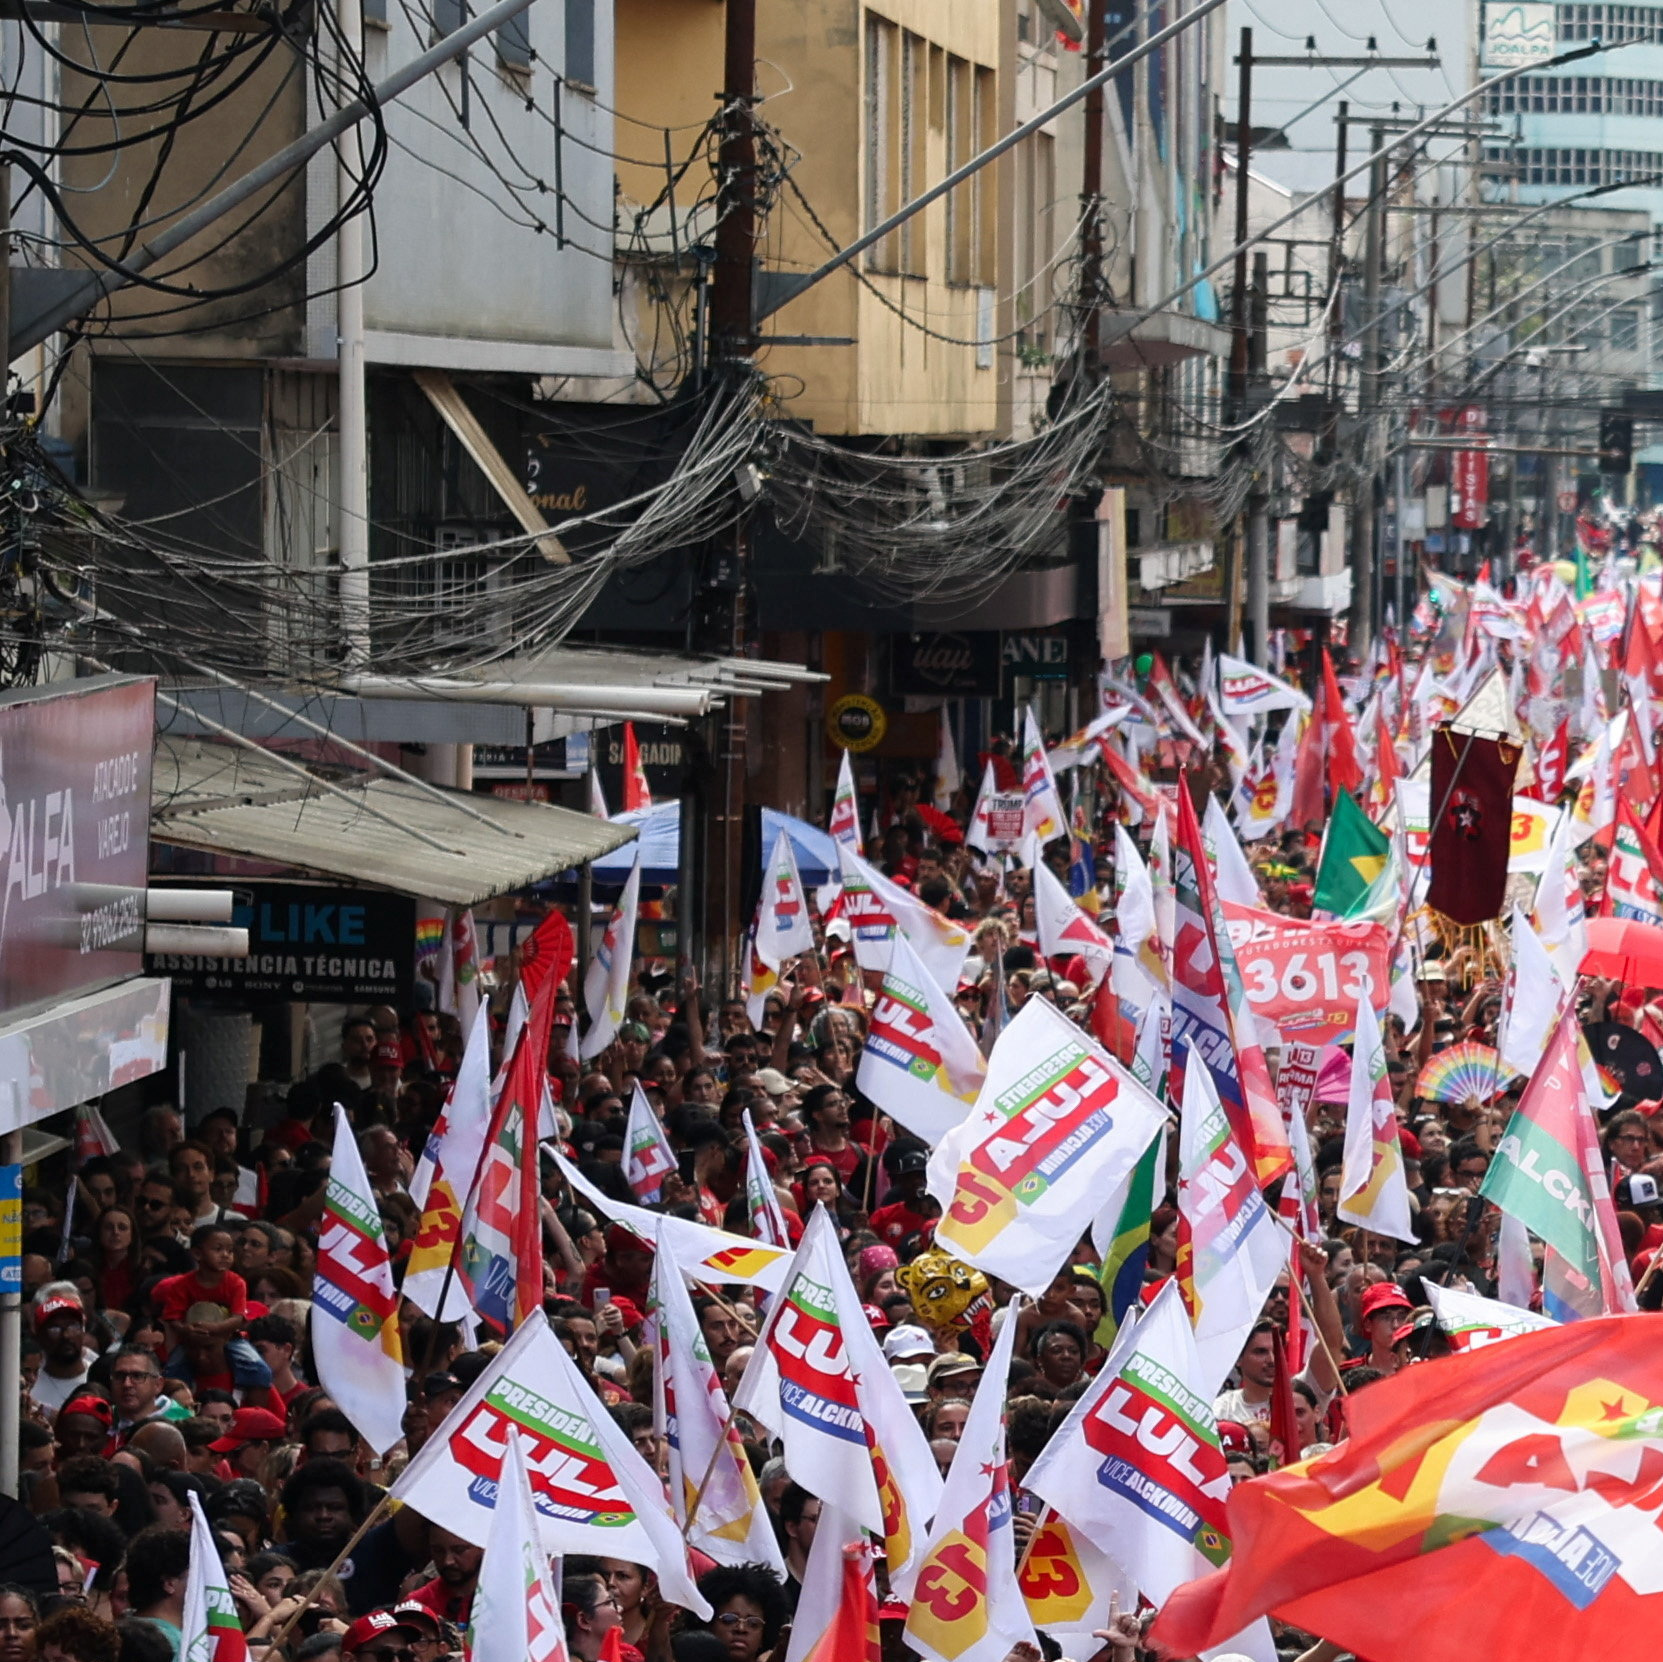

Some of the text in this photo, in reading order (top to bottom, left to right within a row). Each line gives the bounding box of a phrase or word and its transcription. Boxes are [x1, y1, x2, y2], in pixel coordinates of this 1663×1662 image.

[93, 754, 131, 803] ATACADO
[98, 811, 129, 860] VAREJO
[260, 903, 366, 945] LIKE
[304, 954, 396, 978] TÉCNICA
[882, 972, 930, 1013] SIDENTE
[325, 1180, 382, 1238] SIDENTE
[494, 1378, 600, 1449] PRESIDENT
[803, 1393, 865, 1438] ALCKM
[1102, 1455, 1200, 1535] VICE ALCKMIN
